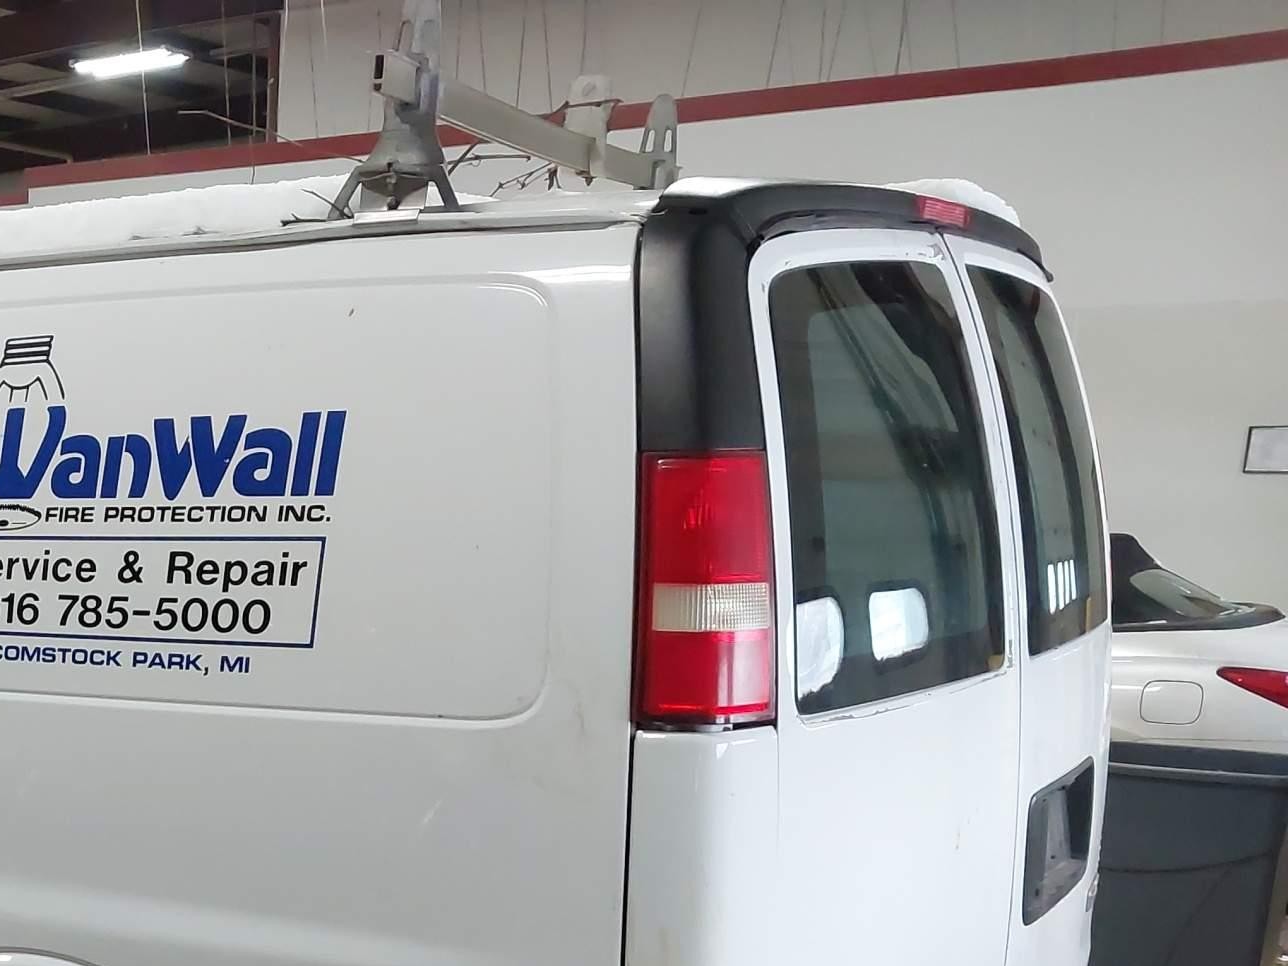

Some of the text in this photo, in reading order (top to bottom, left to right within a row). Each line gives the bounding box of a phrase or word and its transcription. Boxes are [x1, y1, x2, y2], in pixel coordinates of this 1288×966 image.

[44, 505, 332, 522] FIRE PROTECTION INC.
[117, 550, 144, 584] &
[166, 551, 308, 592] Repair
[57, 594, 272, 634] 785-5000
[131, 653, 210, 676] PARK,
[219, 656, 251, 673] MI
